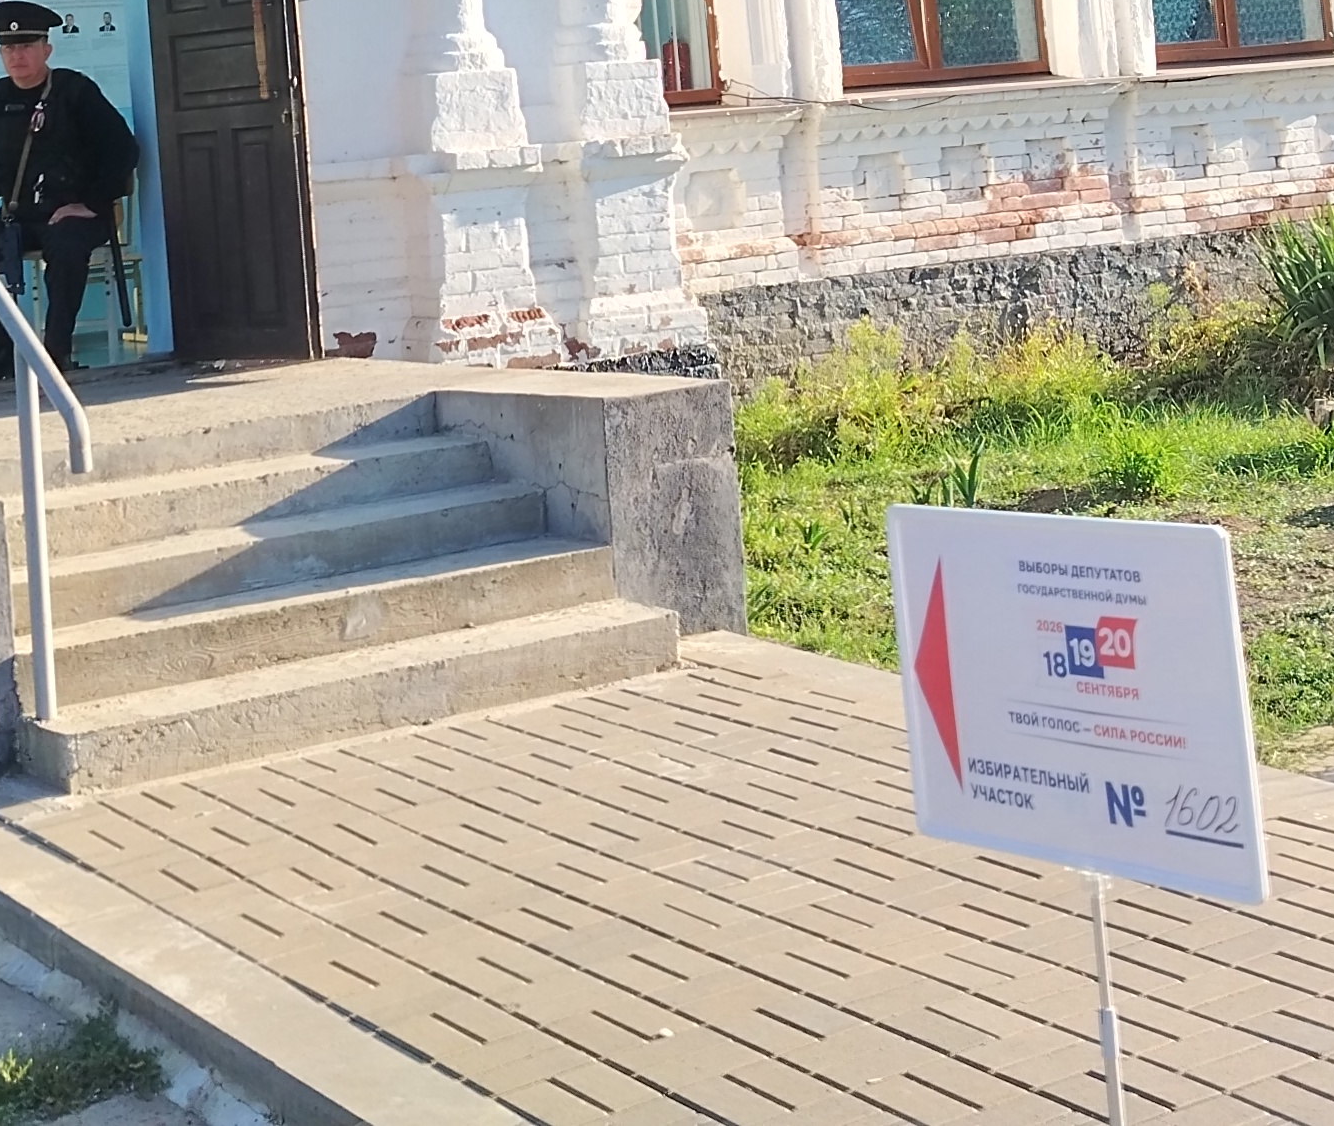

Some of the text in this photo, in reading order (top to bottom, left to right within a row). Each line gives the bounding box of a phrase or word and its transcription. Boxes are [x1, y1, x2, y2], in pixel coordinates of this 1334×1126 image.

[1018, 560, 1141, 583] ВЫБОРЫ ДЕПУТАТОВ
[1017, 583, 1147, 605] ГОСУДАРСТВЕННОЙ ДУМЫ
[1036, 619, 1063, 633] 2026
[1043, 627, 1131, 678] 18 19 20
[1076, 681, 1139, 700] СЕНТЯБРЯ
[1008, 711, 1039, 727] ТВОЙ
[1042, 715, 1080, 733] ГОЛОС
[1094, 724, 1127, 740] СИЛА
[1130, 729, 1187, 749] РОССИИ!
[968, 757, 1090, 794] ИЗБИРАТЕЛЬНЫЙ
[970, 782, 1034, 810] УЧАСТОК
[1105, 781, 1241, 833] № 1602
